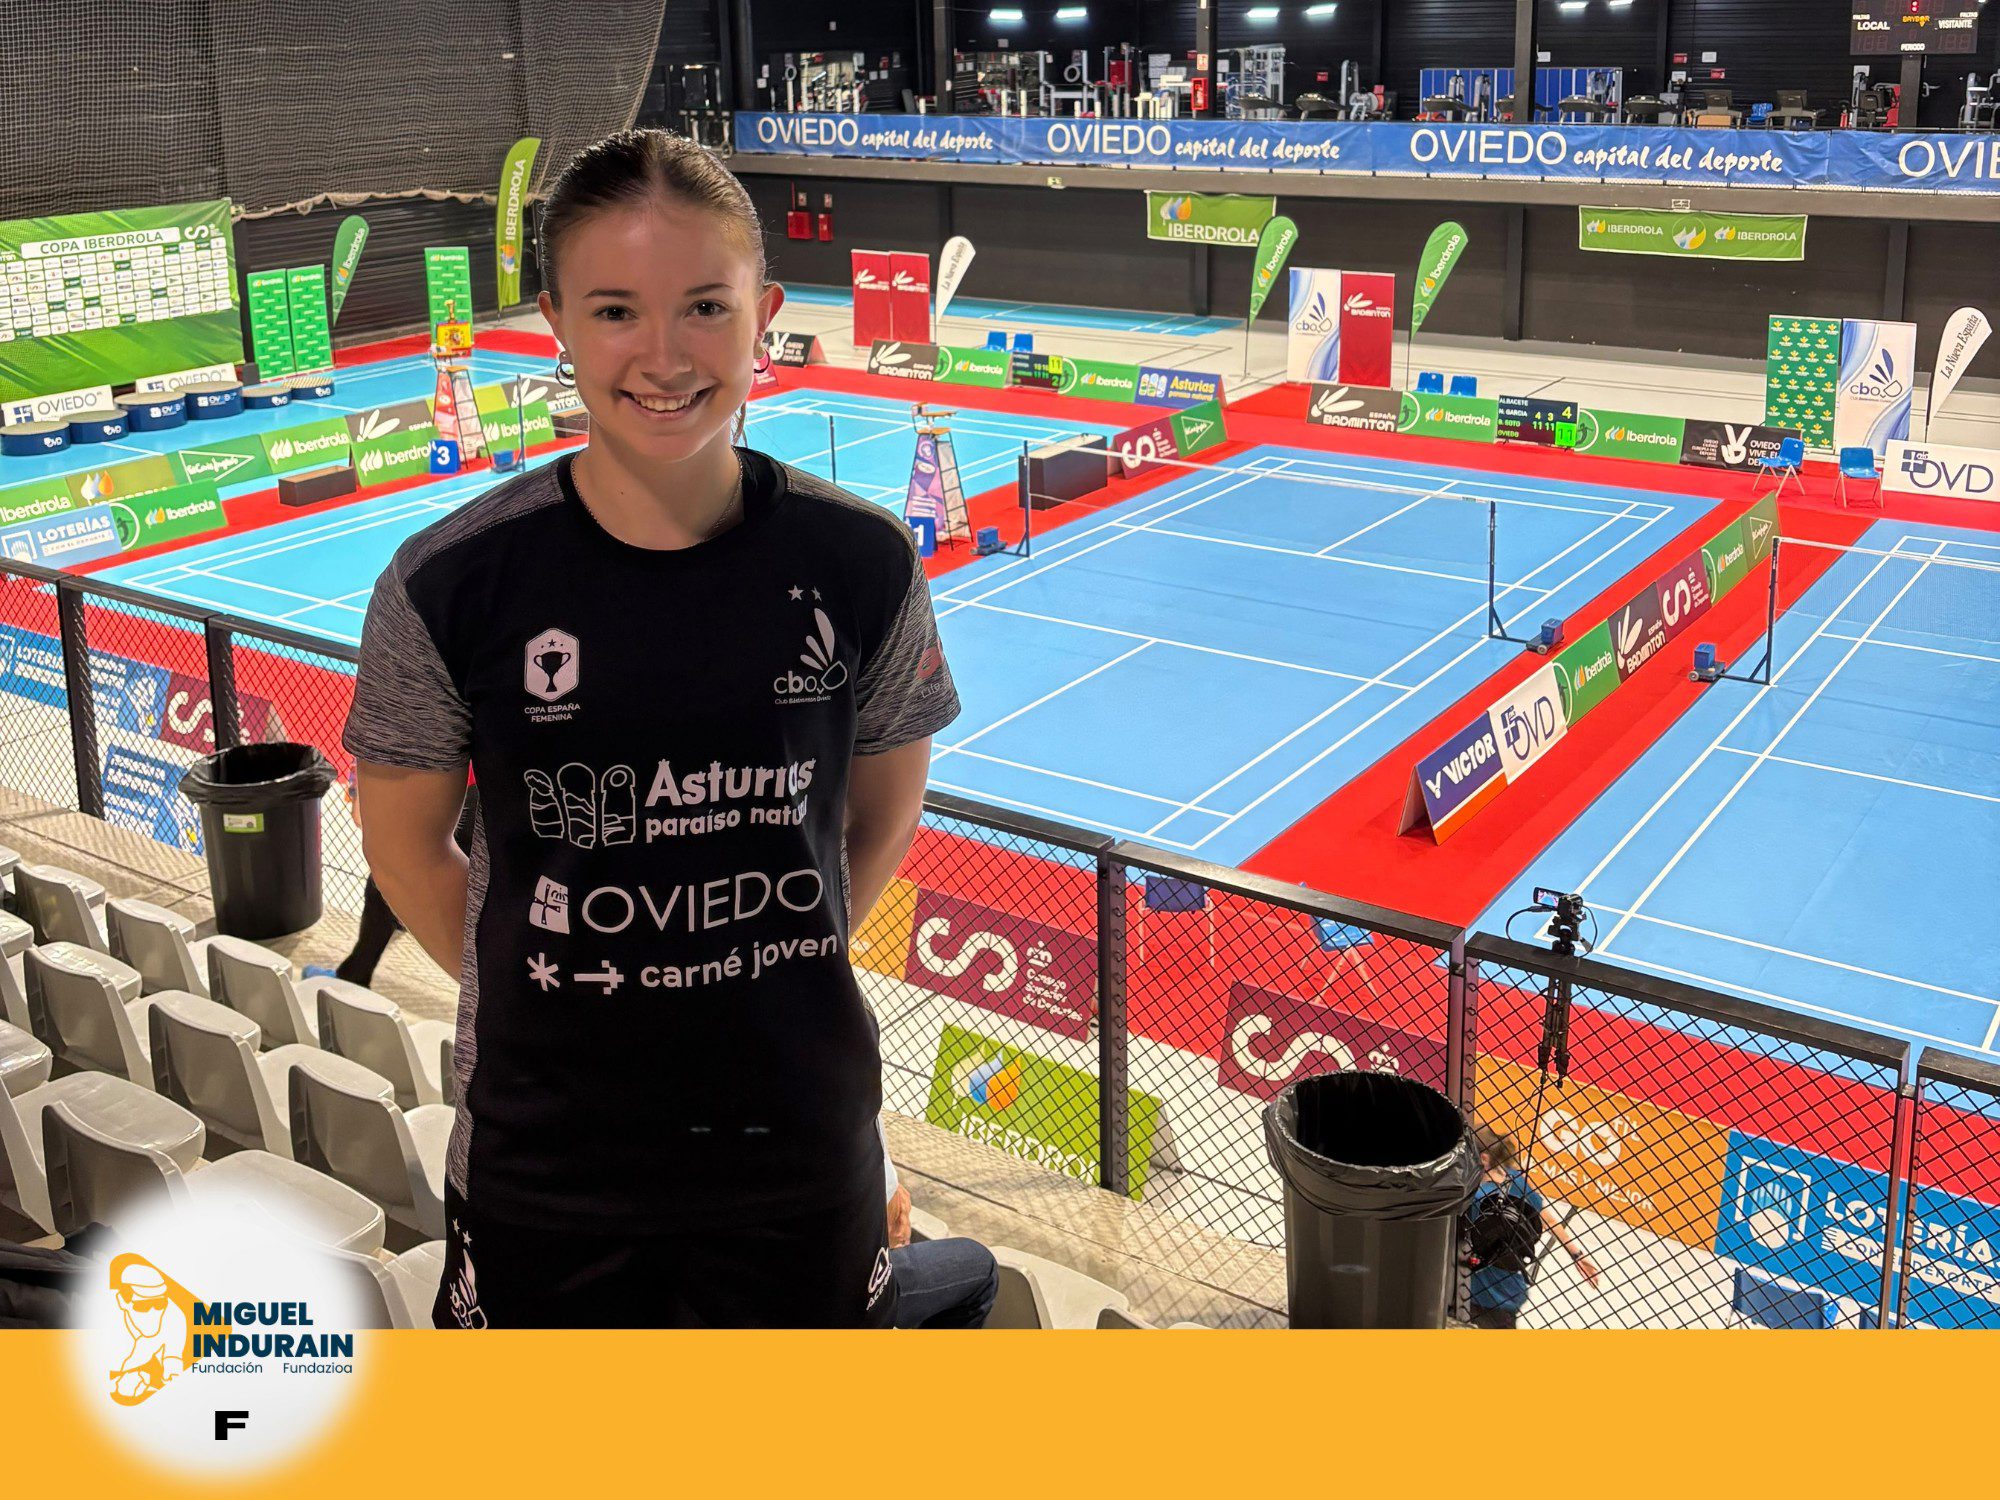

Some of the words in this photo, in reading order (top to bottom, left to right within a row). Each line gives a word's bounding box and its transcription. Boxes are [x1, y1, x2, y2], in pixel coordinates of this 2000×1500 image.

[1857, 21, 1890, 31] LOCAL
[1938, 19, 1973, 29] VISITANTE
[757, 116, 859, 147] OVIEDO
[861, 130, 911, 151] capital
[912, 128, 937, 149] del
[939, 131, 993, 153] deporte
[1046, 124, 1172, 156] OVIEDO
[1174, 137, 1235, 160] capital
[1239, 138, 1269, 160] del
[1272, 139, 1340, 163] deporte
[1410, 128, 1567, 165] OVIEDO
[1573, 145, 1650, 171] capital
[1655, 145, 1694, 172] del
[1699, 147, 1783, 175] deporte
[504, 158, 527, 241] IBERDROLA
[1168, 222, 1260, 243] IBERDROLA
[1607, 224, 1663, 236] IBERDROLA
[1737, 231, 1797, 242] IBERDROLA
[40, 244, 79, 255] COPA
[83, 231, 164, 250] IBERDROLA
[343, 227, 365, 269] Iberdrola
[1266, 228, 1293, 272] Iberdrola
[1431, 234, 1461, 279] Iberdrola
[1958, 313, 1979, 347] España
[1945, 340, 1964, 369] Nueva
[878, 365, 932, 381] BADMINTON
[969, 362, 1004, 376] Iberdrola
[1940, 364, 1953, 380] La
[1095, 375, 1133, 389] Iberdrola
[1170, 375, 1216, 394] Asturias
[37, 393, 97, 416] OVIEDO
[1534, 411, 1541, 420] 4
[1547, 412, 1554, 421] 3
[1561, 405, 1572, 420] 4
[1323, 414, 1395, 432] BADMINTON
[1444, 411, 1491, 427] Iberdrola
[1532, 420, 1543, 430] 11
[1545, 421, 1554, 431] 11
[293, 430, 350, 454] Iberdrola
[1559, 428, 1573, 440] 11
[1626, 429, 1677, 447] Iberdrola
[1750, 440, 1781, 449] OVIEDO
[383, 438, 436, 467] Iberdrol
[437, 445, 450, 466] 3
[1749, 448, 1767, 457] VIVE
[1909, 459, 1994, 494] OVD
[1, 494, 72, 523] Iberdrola
[165, 499, 217, 520] Iberdrola
[37, 515, 111, 544] LOTERÍAS
[913, 524, 925, 547] 1
[1626, 630, 1666, 674] BADMINTON
[1584, 650, 1613, 682] Iberdrola
[524, 706, 546, 714] COPA
[547, 702, 581, 713] ESPAÑA
[531, 713, 573, 723] FEMENINA
[1512, 695, 1555, 761] OVD
[1443, 732, 1497, 785] VICTOR
[644, 757, 817, 808] Asturias
[645, 807, 741, 844] paraíso
[581, 868, 824, 934] OVIEDO
[640, 945, 743, 988] carné
[750, 933, 838, 980] joven
[1540, 1107, 1622, 1167] GO
[1542, 1162, 1579, 1187] MÁS
[1582, 1175, 1594, 1191] Y
[1595, 1180, 1655, 1213] MEJOR
[1825, 1191, 2000, 1269] LOTERÍA
[1843, 1239, 1880, 1259] CON
[1912, 1259, 1993, 1296] DEPORTE
